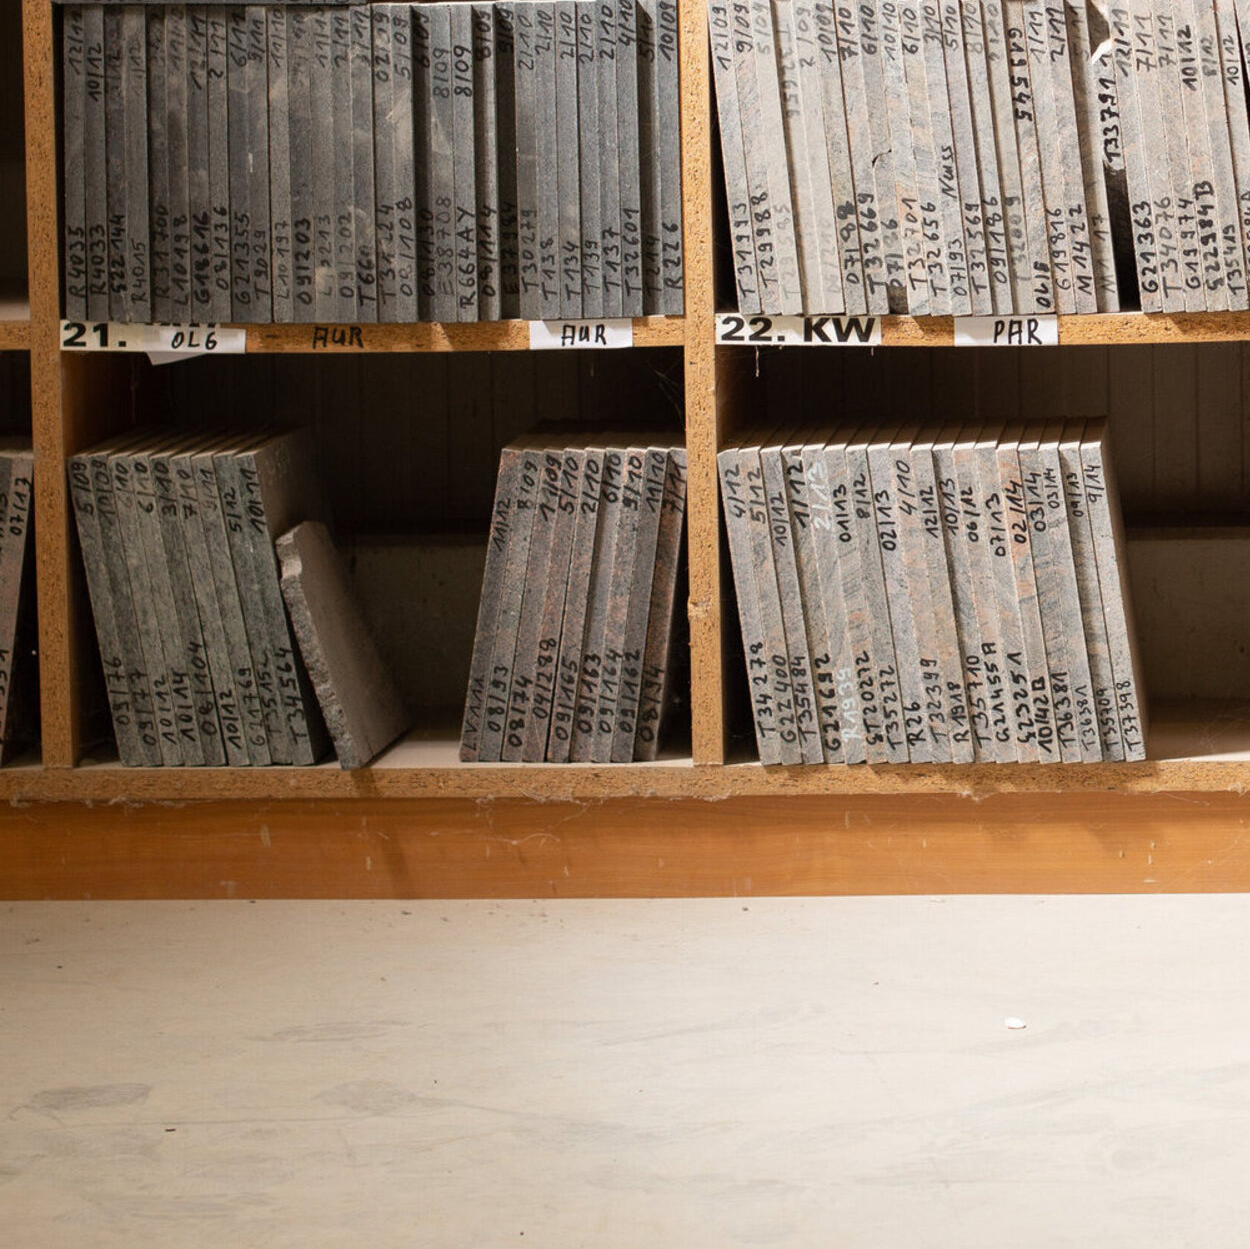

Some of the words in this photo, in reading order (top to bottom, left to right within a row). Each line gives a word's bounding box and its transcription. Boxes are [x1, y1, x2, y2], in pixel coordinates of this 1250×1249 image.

[62, 324, 127, 348] 21.
[312, 325, 363, 350] AUR
[561, 325, 606, 347] AUR
[721, 317, 785, 342] 22.
[803, 317, 875, 342] KW
[994, 319, 1042, 344] PAR
